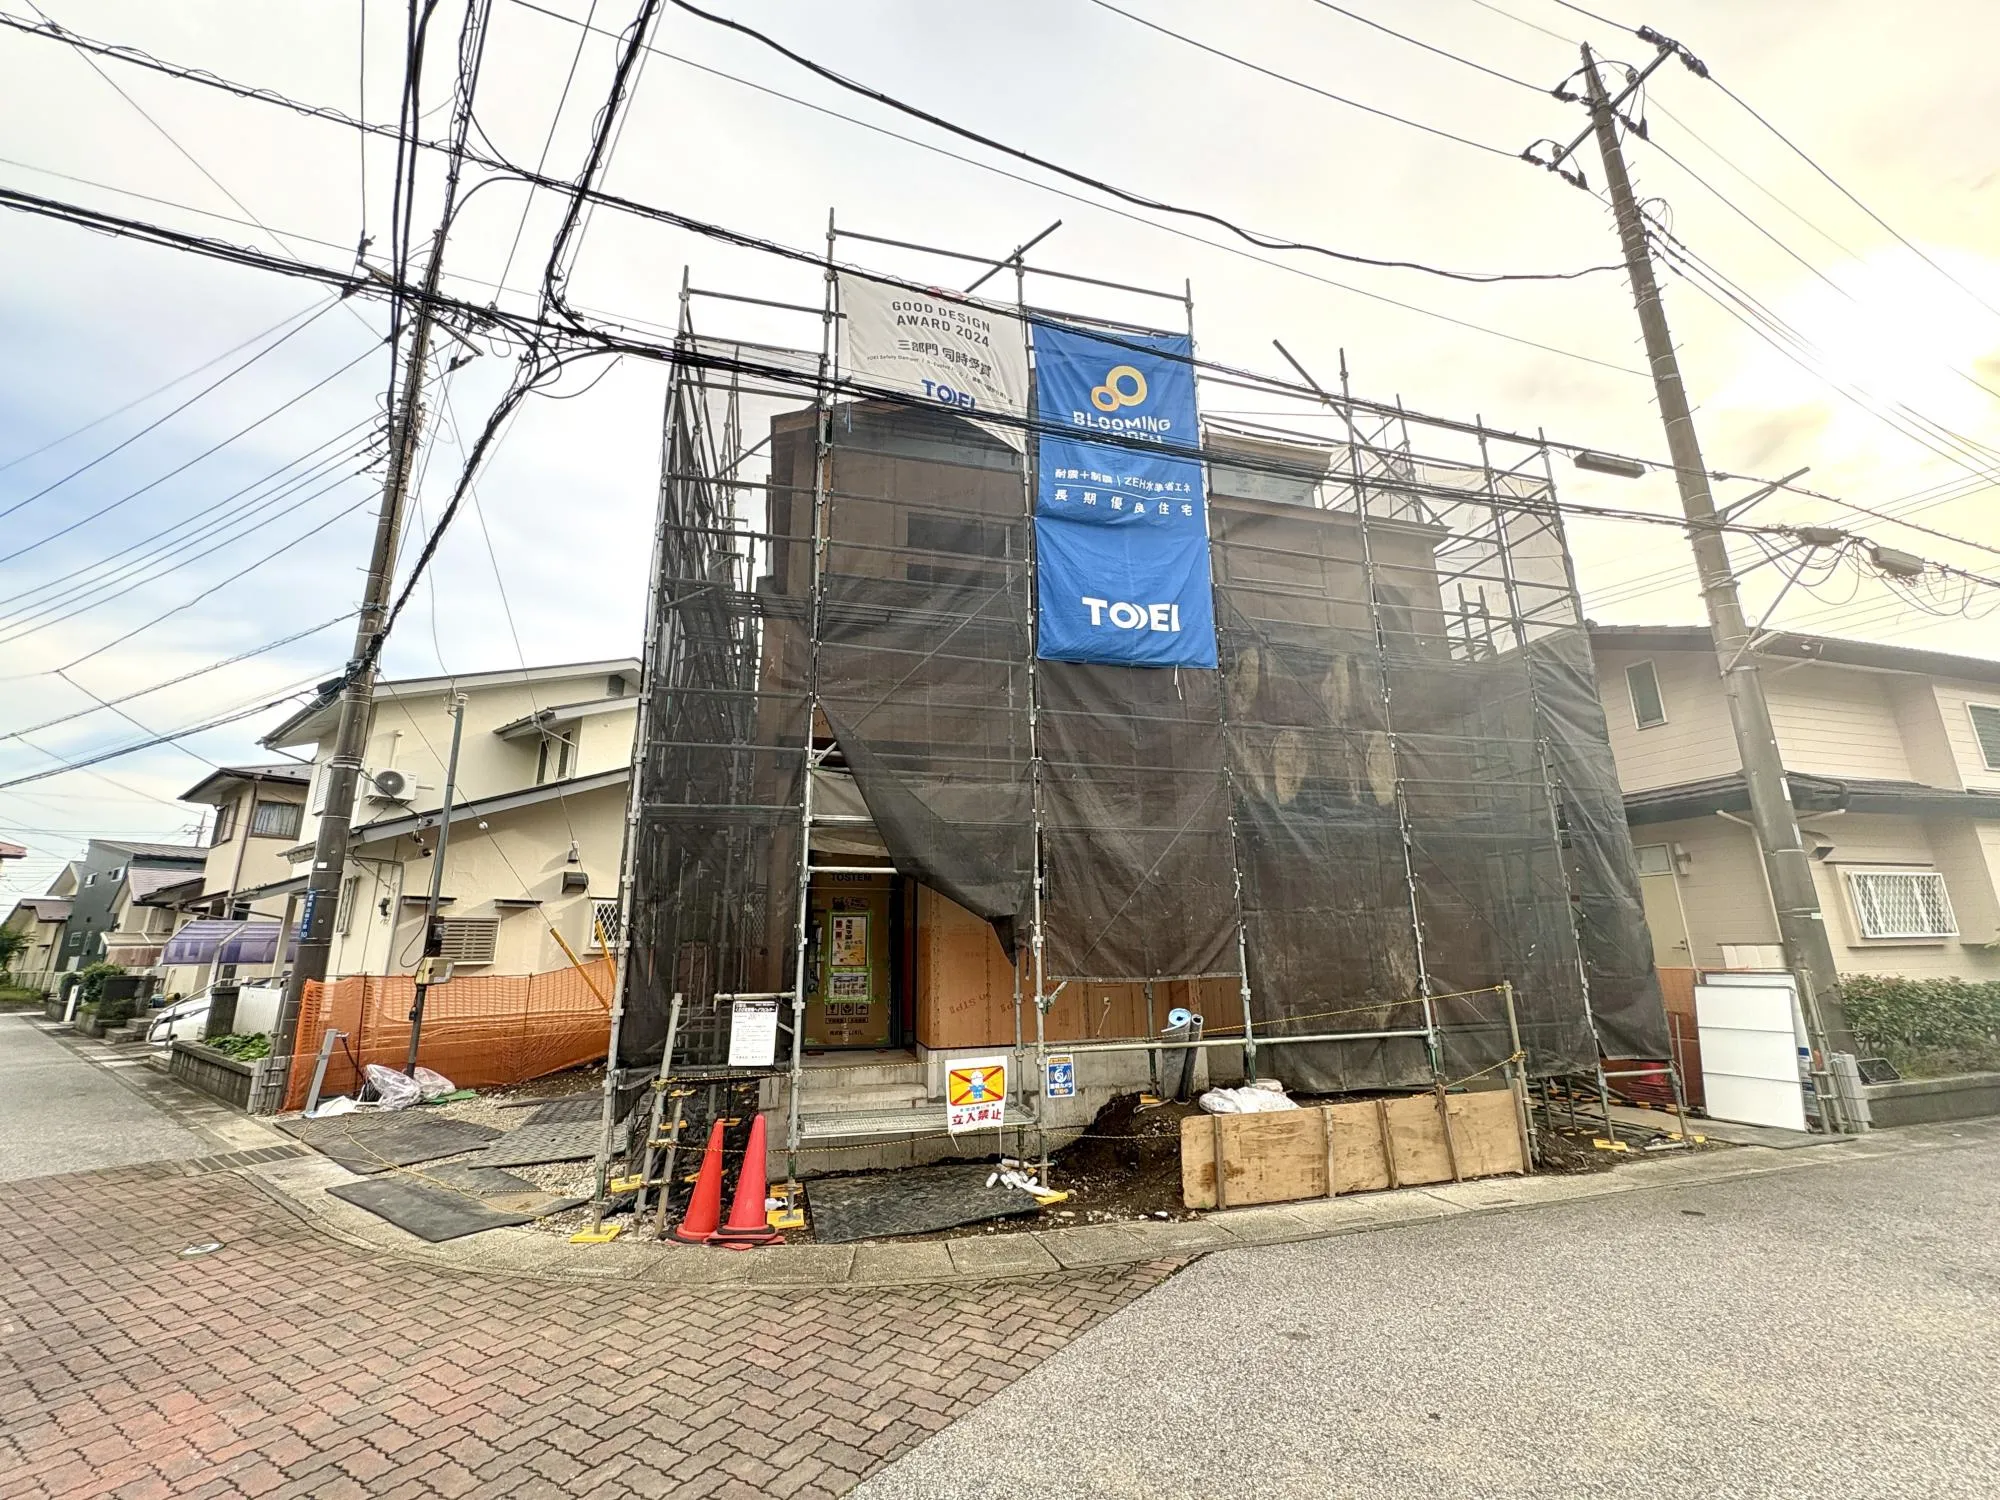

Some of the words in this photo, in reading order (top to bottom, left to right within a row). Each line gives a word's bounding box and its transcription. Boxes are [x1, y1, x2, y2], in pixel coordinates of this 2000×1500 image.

[892, 301, 933, 314] GOOD
[938, 307, 990, 333] DESIGN
[897, 315, 950, 331] AWARD
[956, 325, 989, 347] 2024
[897, 340, 938, 356] 三部門
[942, 347, 992, 378] 同時受賞
[1073, 411, 1171, 433] BLOOMING
[1054, 489, 1193, 516] 長期優良住宅
[1082, 596, 1180, 631] TOEI
[952, 1109, 1002, 1126] 立入禁止
